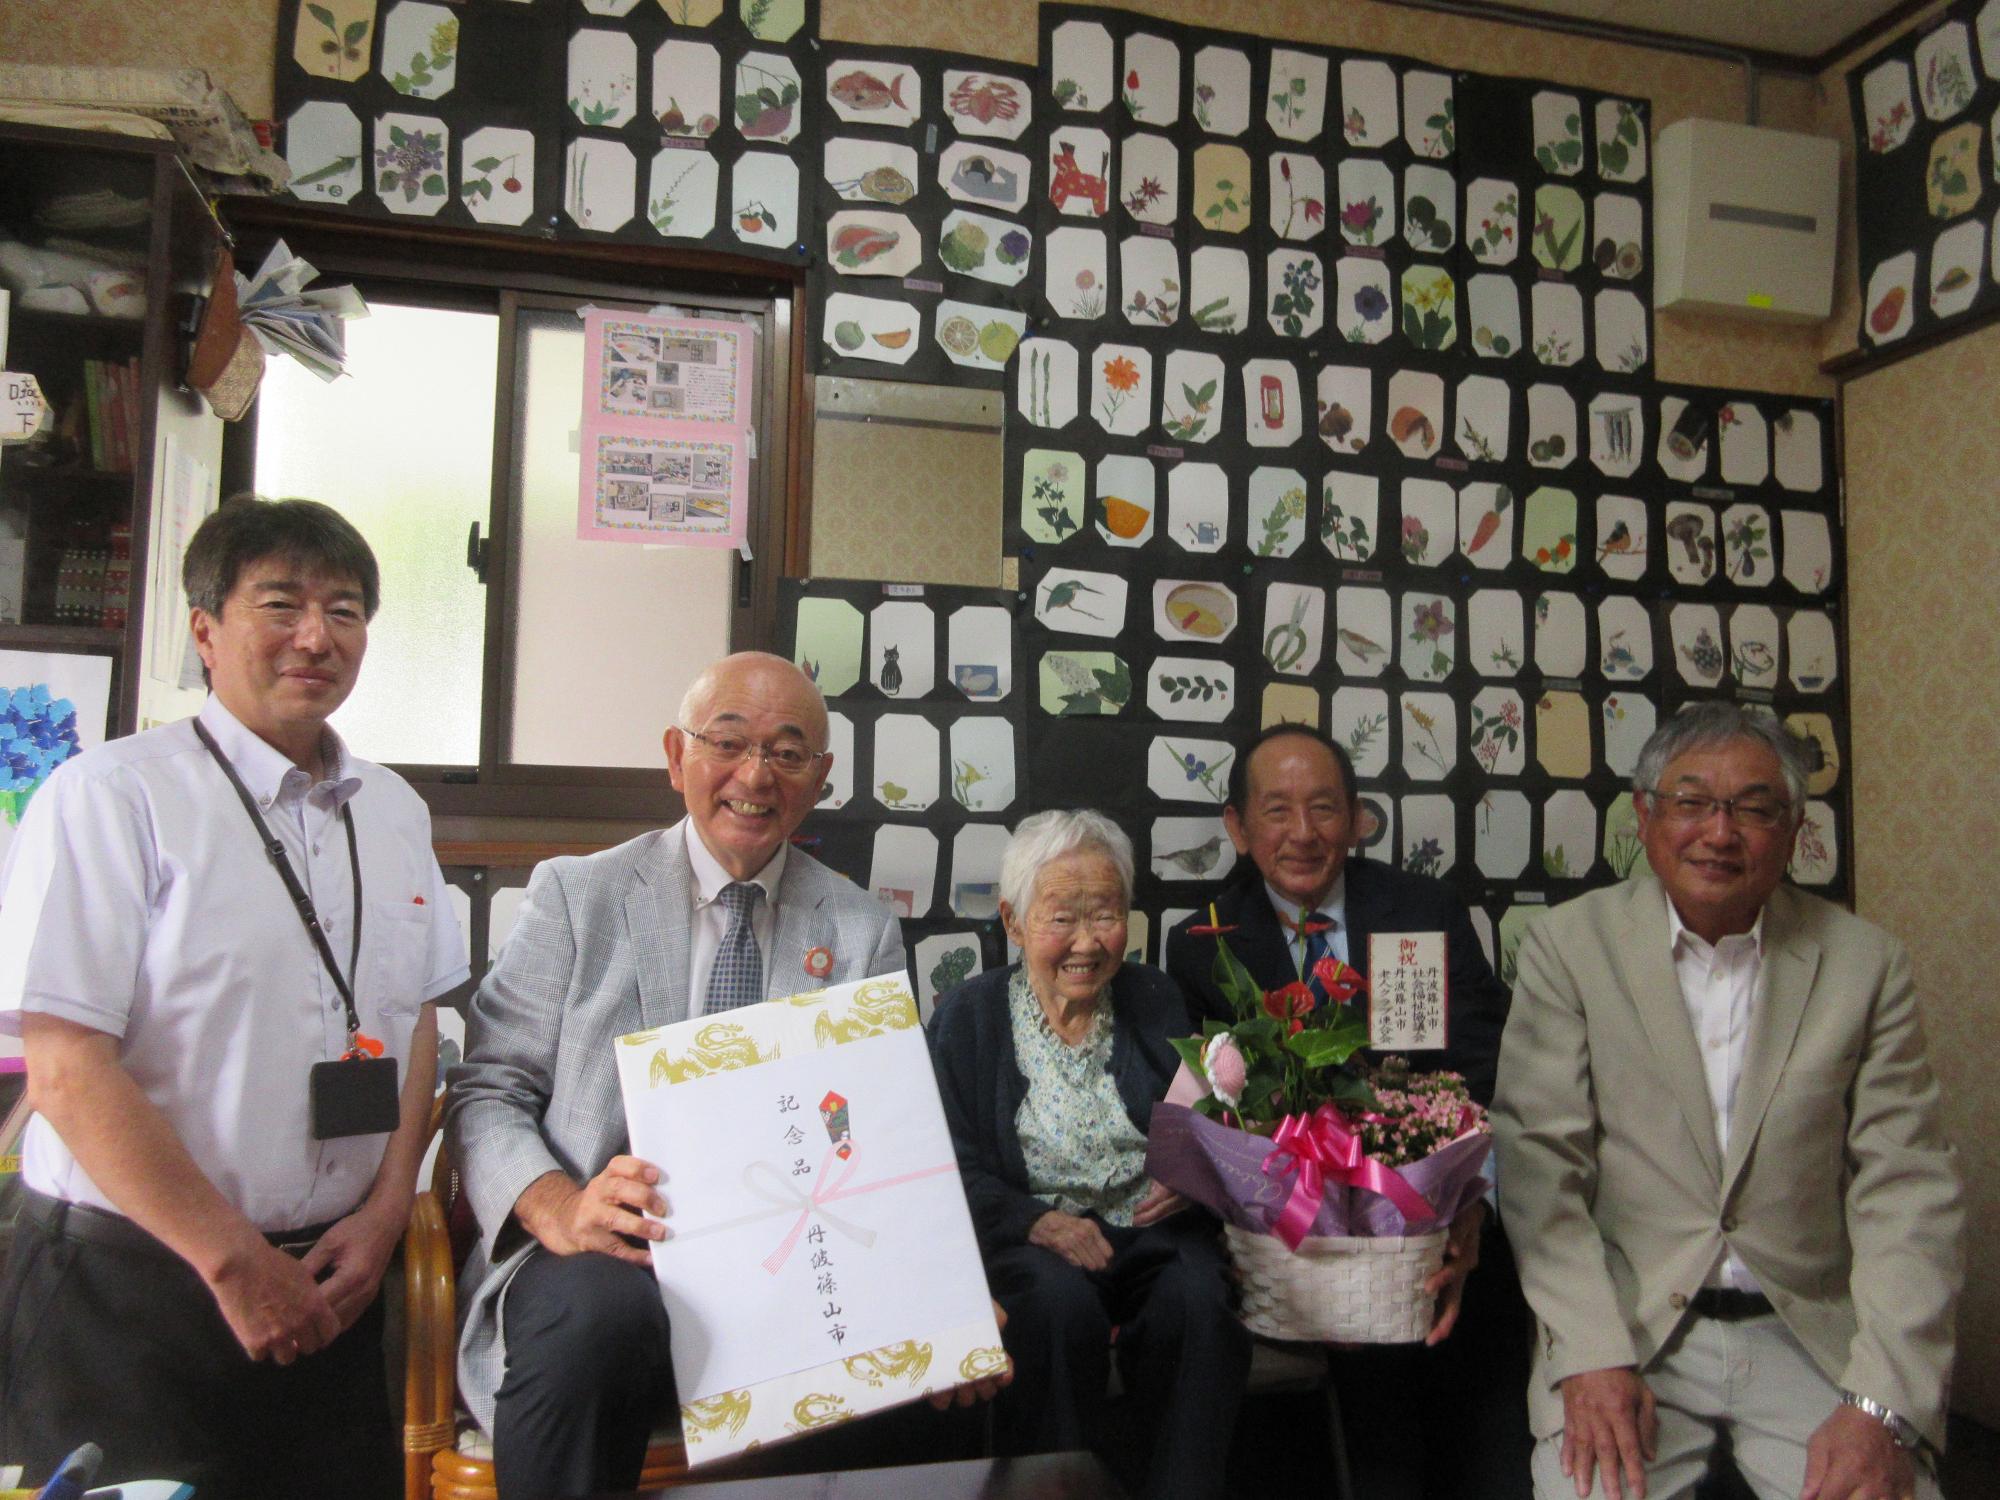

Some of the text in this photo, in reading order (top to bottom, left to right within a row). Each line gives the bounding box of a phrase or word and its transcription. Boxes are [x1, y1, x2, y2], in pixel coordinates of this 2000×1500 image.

[777, 1095, 812, 1176] 記念品
[807, 1224, 847, 1345] 丹波篠山市
